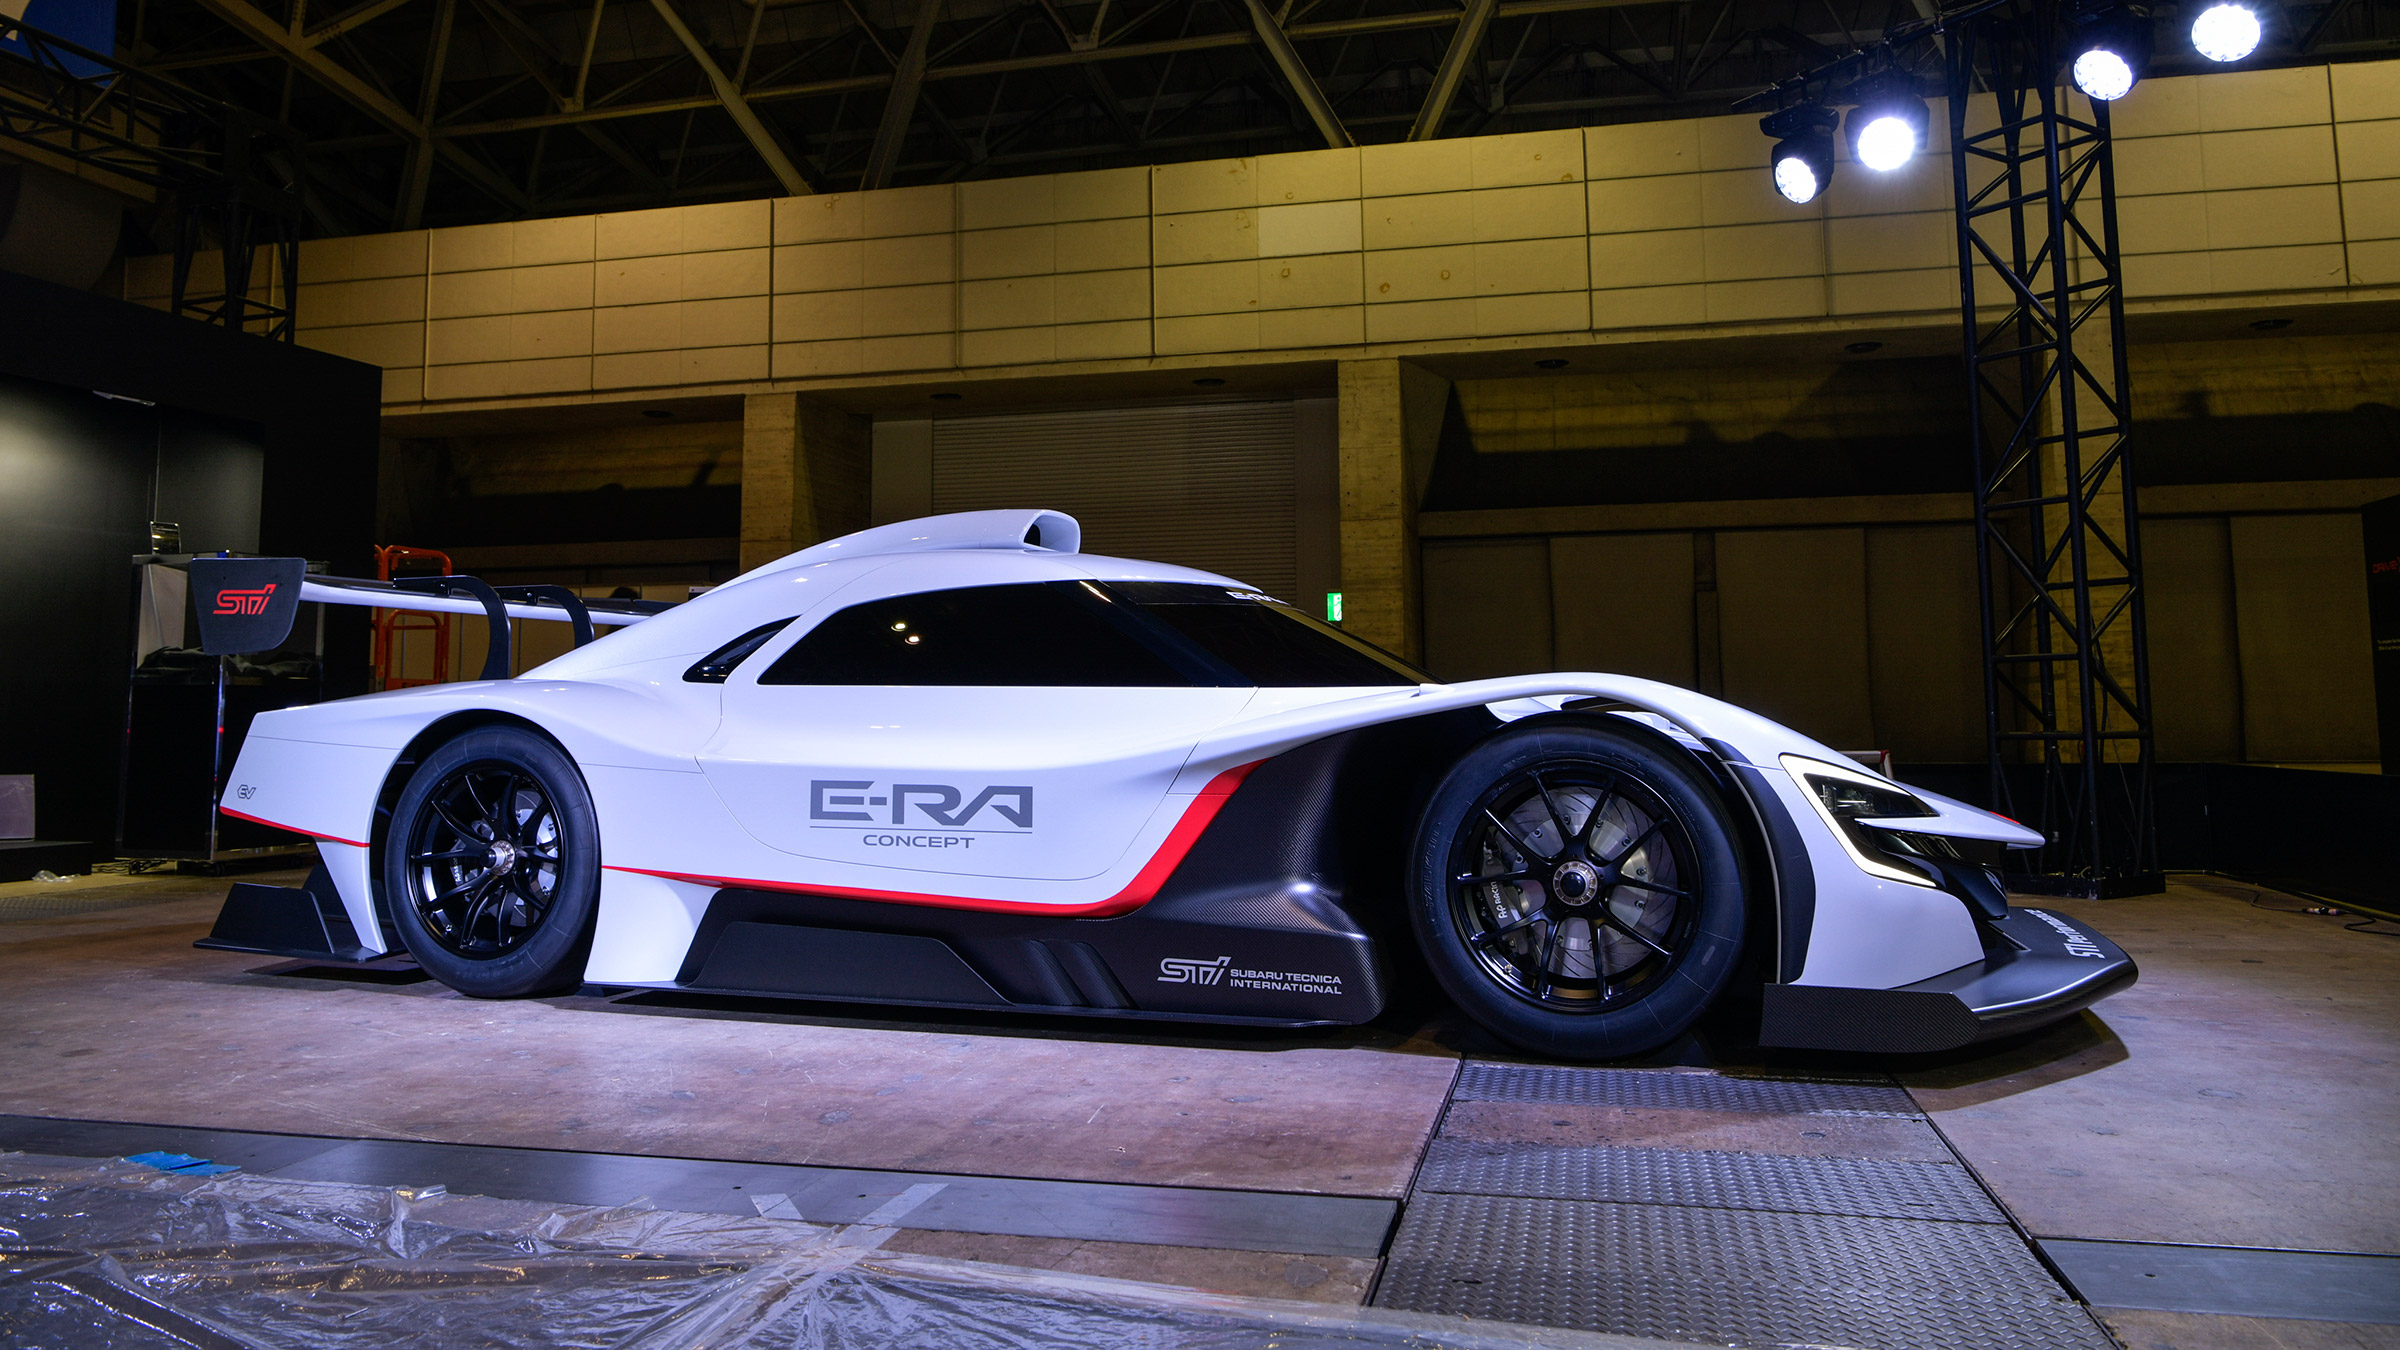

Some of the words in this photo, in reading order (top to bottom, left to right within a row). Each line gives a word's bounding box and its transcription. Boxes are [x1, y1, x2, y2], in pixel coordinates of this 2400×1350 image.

[236, 783, 257, 800] EV
[809, 779, 1034, 828] E-RA
[862, 834, 975, 849] CONCEPT
[1229, 968, 1283, 981] SUBARU
[1285, 972, 1342, 985] TECNICA
[1229, 978, 1343, 995] INTERNATIONAL
